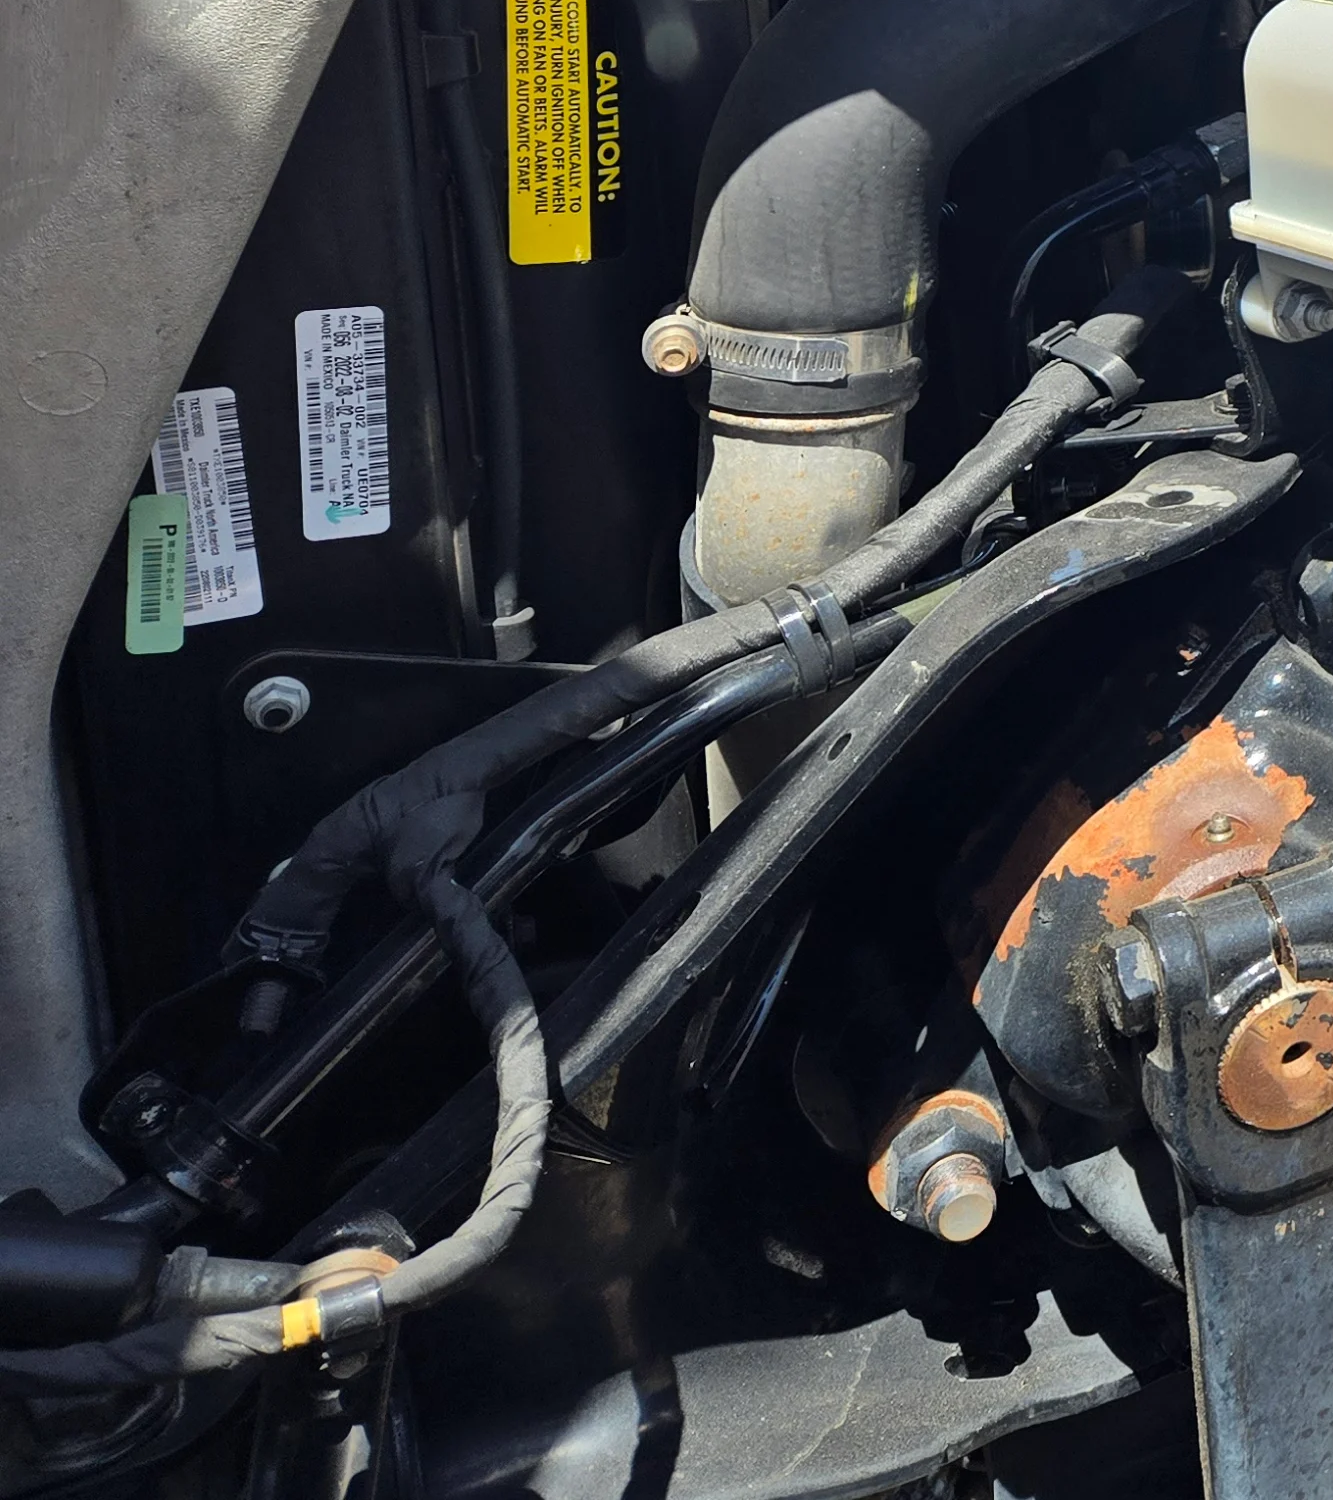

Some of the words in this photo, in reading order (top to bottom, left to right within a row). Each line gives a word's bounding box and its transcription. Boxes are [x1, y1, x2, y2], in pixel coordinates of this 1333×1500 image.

[532, 20, 546, 41] ON
[567, 1, 579, 44] COULD
[516, 29, 529, 74] BEFORE
[533, 45, 547, 71] FAN
[551, 46, 564, 80] TURN
[568, 48, 580, 84] START
[534, 75, 547, 93] OR
[516, 78, 530, 152] AUTOMATIC
[534, 98, 547, 135] BELTS.
[551, 84, 565, 143] IGNITION
[596, 51, 621, 202] CAUTION:
[568, 88, 582, 192] AUTOMATICALLY.
[534, 139, 548, 183] ALARM
[552, 147, 565, 170] OFF
[517, 156, 530, 194] START.
[535, 186, 548, 215] WILL
[552, 174, 566, 214] WHEN
[569, 196, 582, 213] TO
[321, 314, 331, 340] MADE
[333, 331, 351, 347] 056
[322, 343, 332, 353] IN
[322, 355, 333, 390] MEXICO
[176, 399, 185, 418] Made
[180, 428, 190, 452] Mexico
[340, 422, 352, 460] Daimler
[199, 461, 210, 488] Daimler
[341, 462, 354, 490] Truck
[203, 489, 213, 508] Truck
[342, 493, 354, 508] NA
[158, 524, 178, 536] P
[205, 509, 218, 527] North
[208, 528, 220, 556] America
